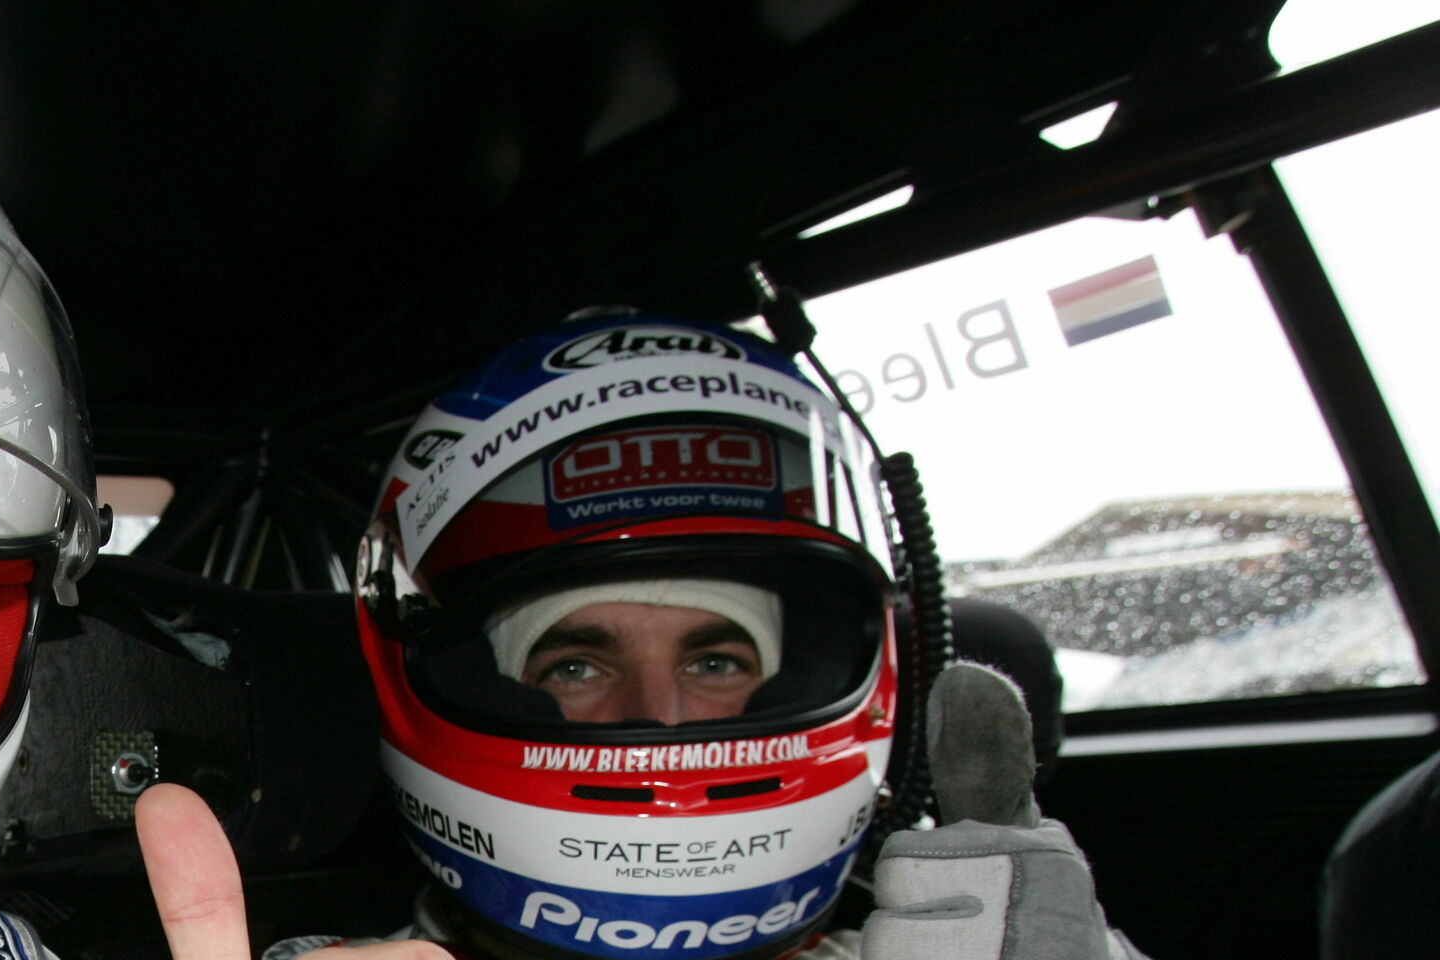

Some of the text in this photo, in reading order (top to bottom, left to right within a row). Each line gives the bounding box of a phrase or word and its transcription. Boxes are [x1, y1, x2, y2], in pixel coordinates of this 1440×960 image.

[563, 330, 718, 365] Arai
[470, 372, 810, 468] www.raceplane
[563, 431, 761, 479] OTTO
[567, 493, 767, 521] Werkt voor twee
[520, 734, 812, 773] WWW.BLEEKEMOLEN.COM
[558, 828, 793, 863] STATE OF ART
[615, 863, 736, 879] MENSWEAR
